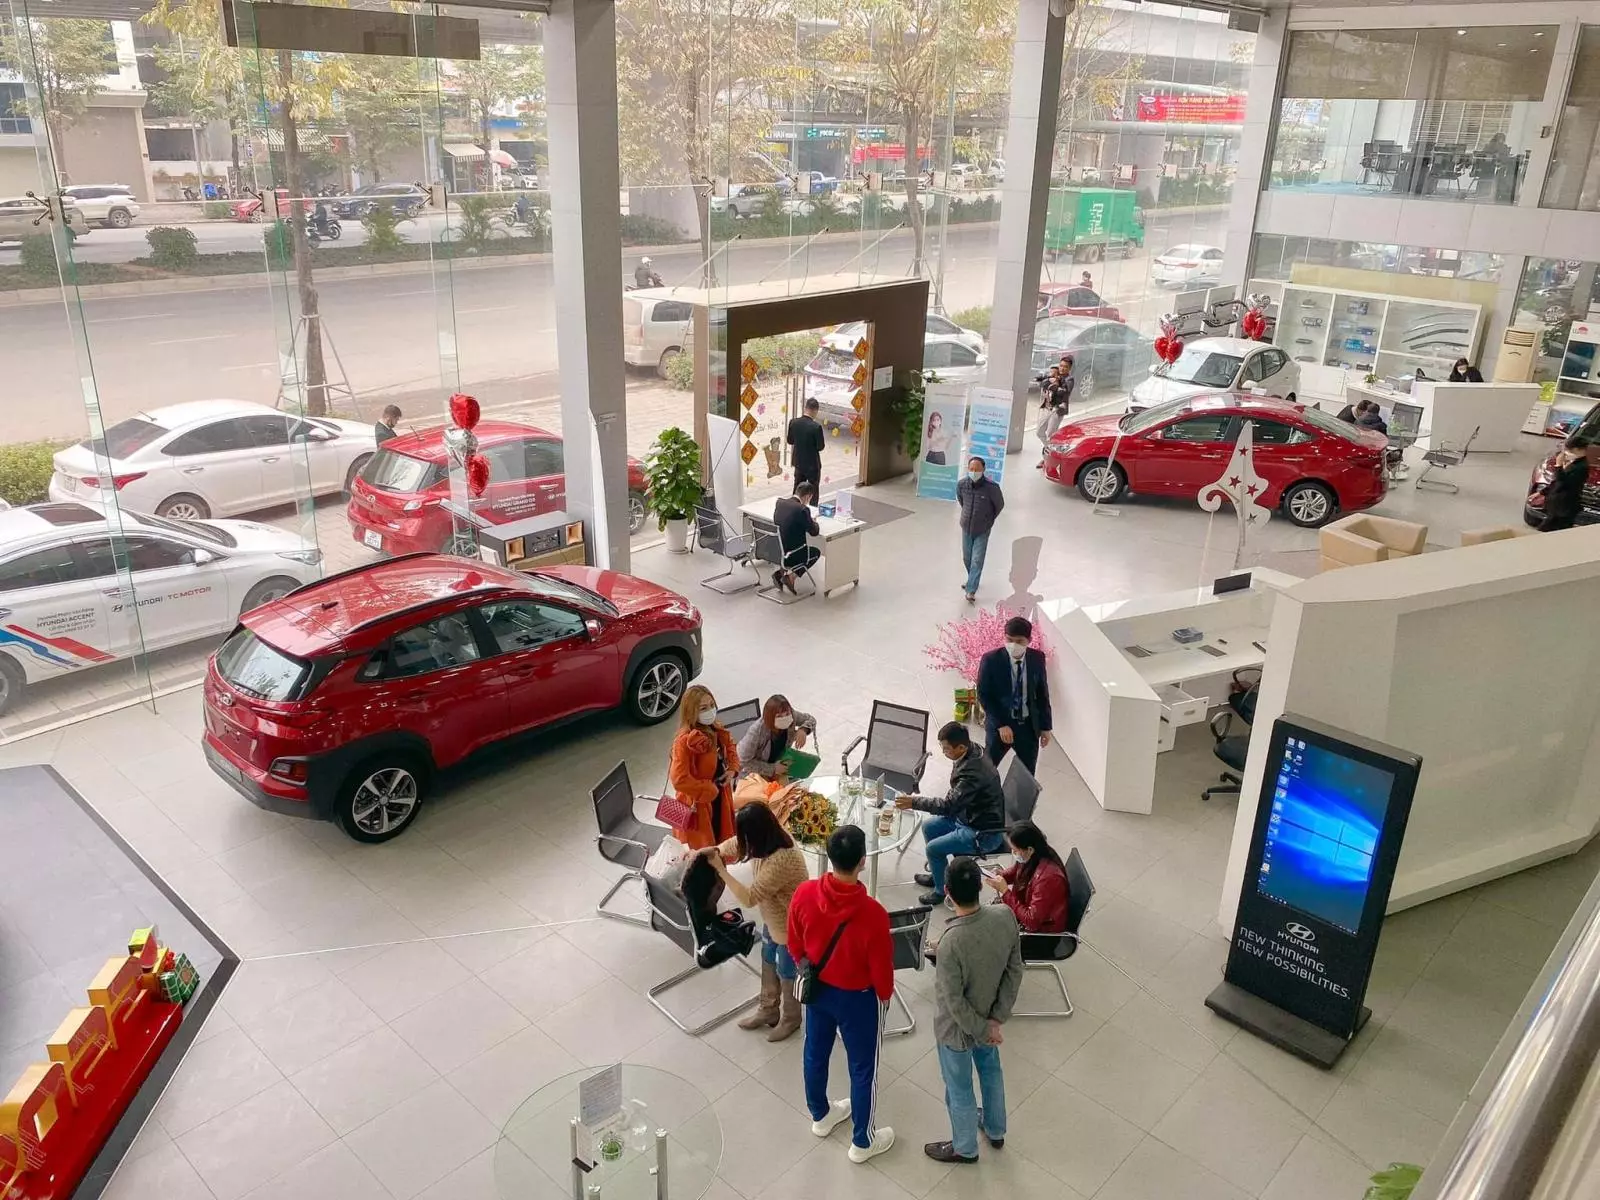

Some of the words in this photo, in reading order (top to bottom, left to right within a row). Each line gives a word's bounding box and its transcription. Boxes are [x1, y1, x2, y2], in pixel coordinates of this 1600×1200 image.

[125, 596, 163, 608] HYUNDAI
[69, 612, 94, 621] ACCENT
[1240, 926, 1267, 945] NEW
[1270, 940, 1327, 975] THINKING.
[1277, 931, 1320, 954] HYUNDAI
[1237, 939, 1265, 958] NEW
[1266, 952, 1351, 1000] POSSIBILITIES.
